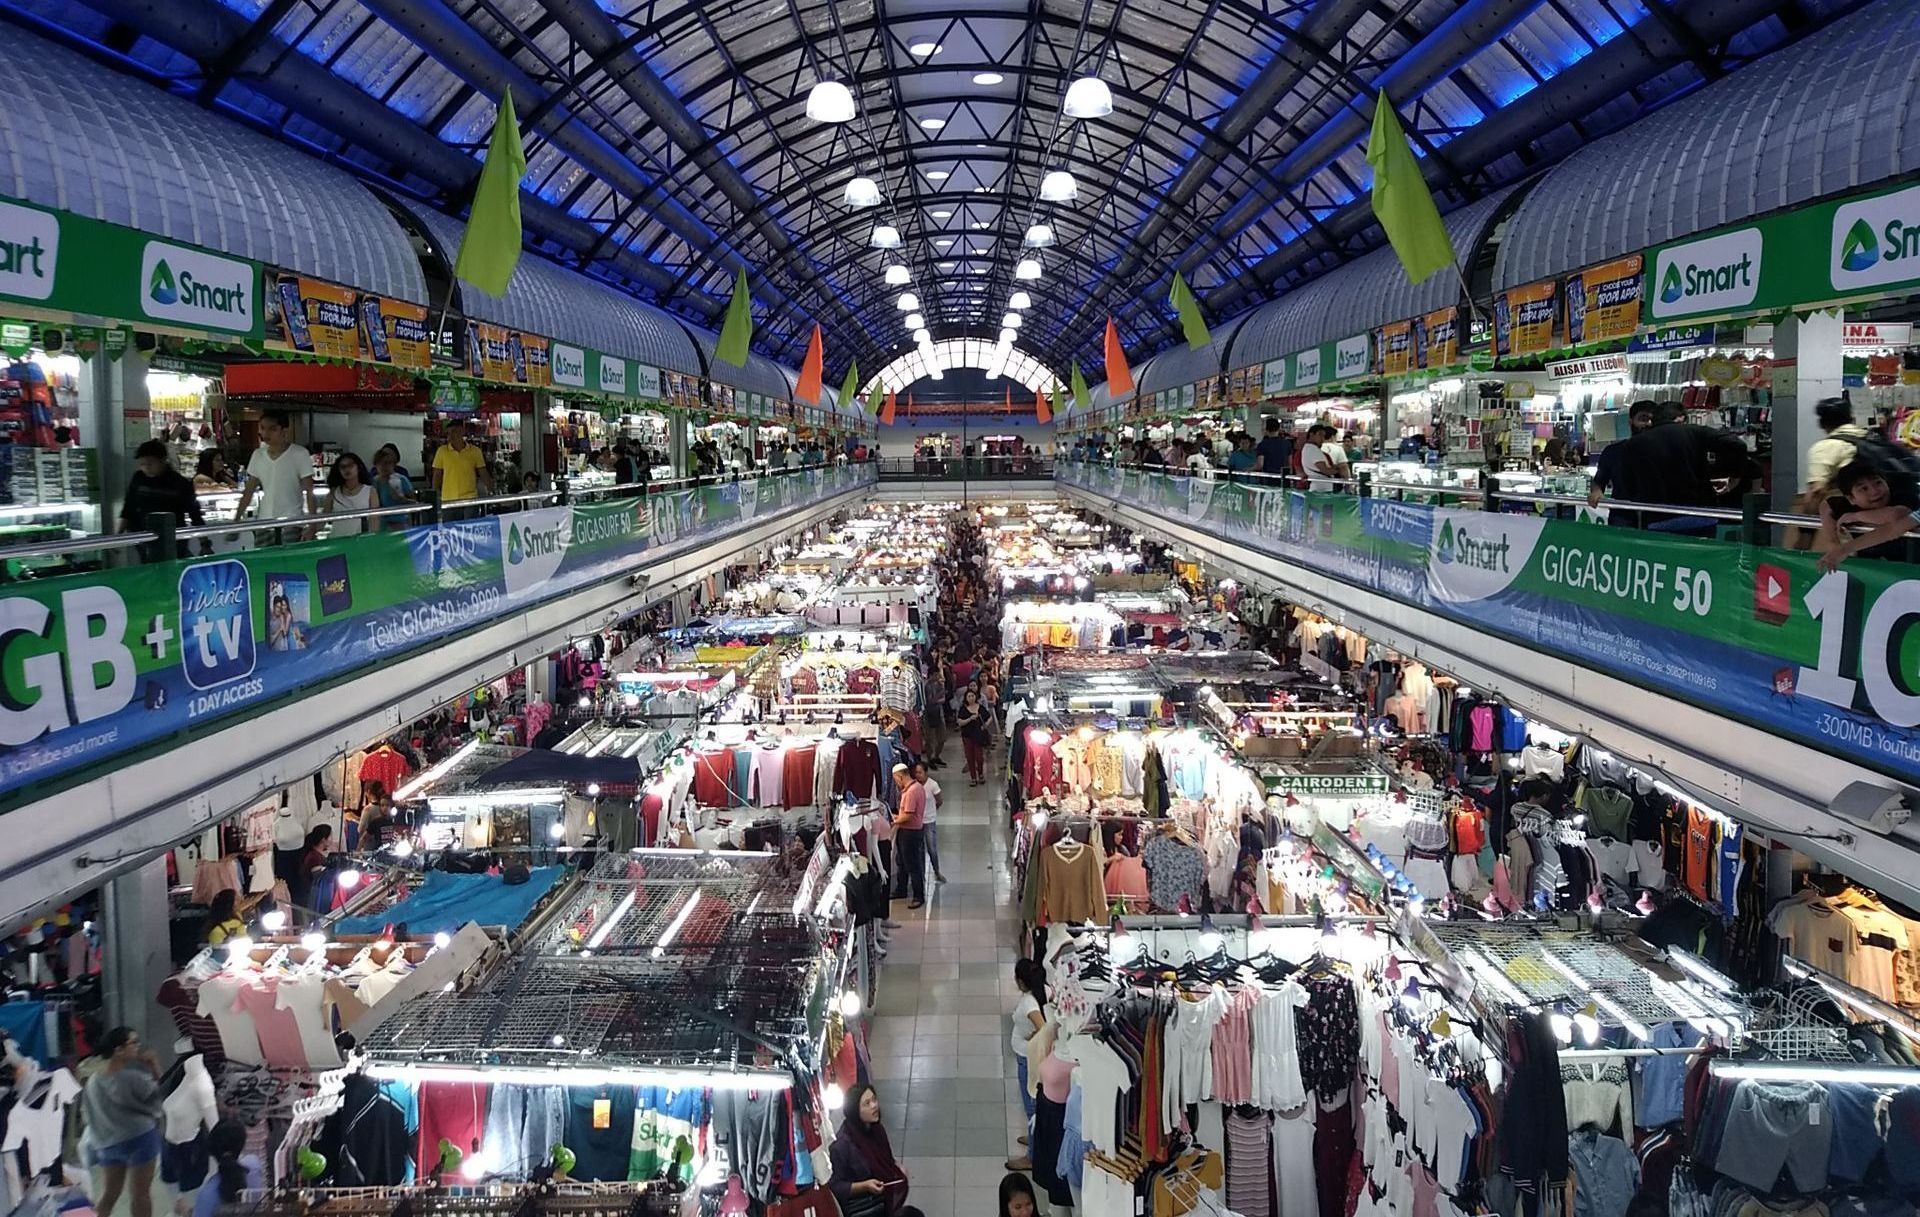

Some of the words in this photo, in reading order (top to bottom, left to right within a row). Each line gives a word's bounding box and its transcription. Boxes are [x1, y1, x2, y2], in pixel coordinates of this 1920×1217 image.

[0, 236, 44, 278] art
[1883, 219, 1920, 261] Sm
[180, 270, 246, 315] Smart
[1685, 252, 1752, 296] Smart
[563, 357, 583, 377] Smart
[608, 367, 624, 386] Smart
[1346, 348, 1366, 367] Smart
[1591, 356, 1626, 372] TELECOM
[523, 521, 563, 558] Smart
[576, 515, 620, 546] GIGASURF
[620, 511, 632, 534] 50
[1456, 527, 1511, 574] Smart
[1542, 543, 1667, 605] GIGASURF
[1673, 566, 1713, 617] 50
[367, 618, 403, 650] Text
[402, 599, 456, 638] GIGA50
[470, 586, 500, 616] 9999
[193, 613, 242, 669] tv
[189, 699, 197, 719] 1
[197, 690, 222, 716] DAY
[220, 678, 264, 709] ACCESS
[63, 738, 85, 759] and
[1280, 777, 1368, 789] CAIRODEN
[1312, 786, 1381, 795] MERCHANDISE
